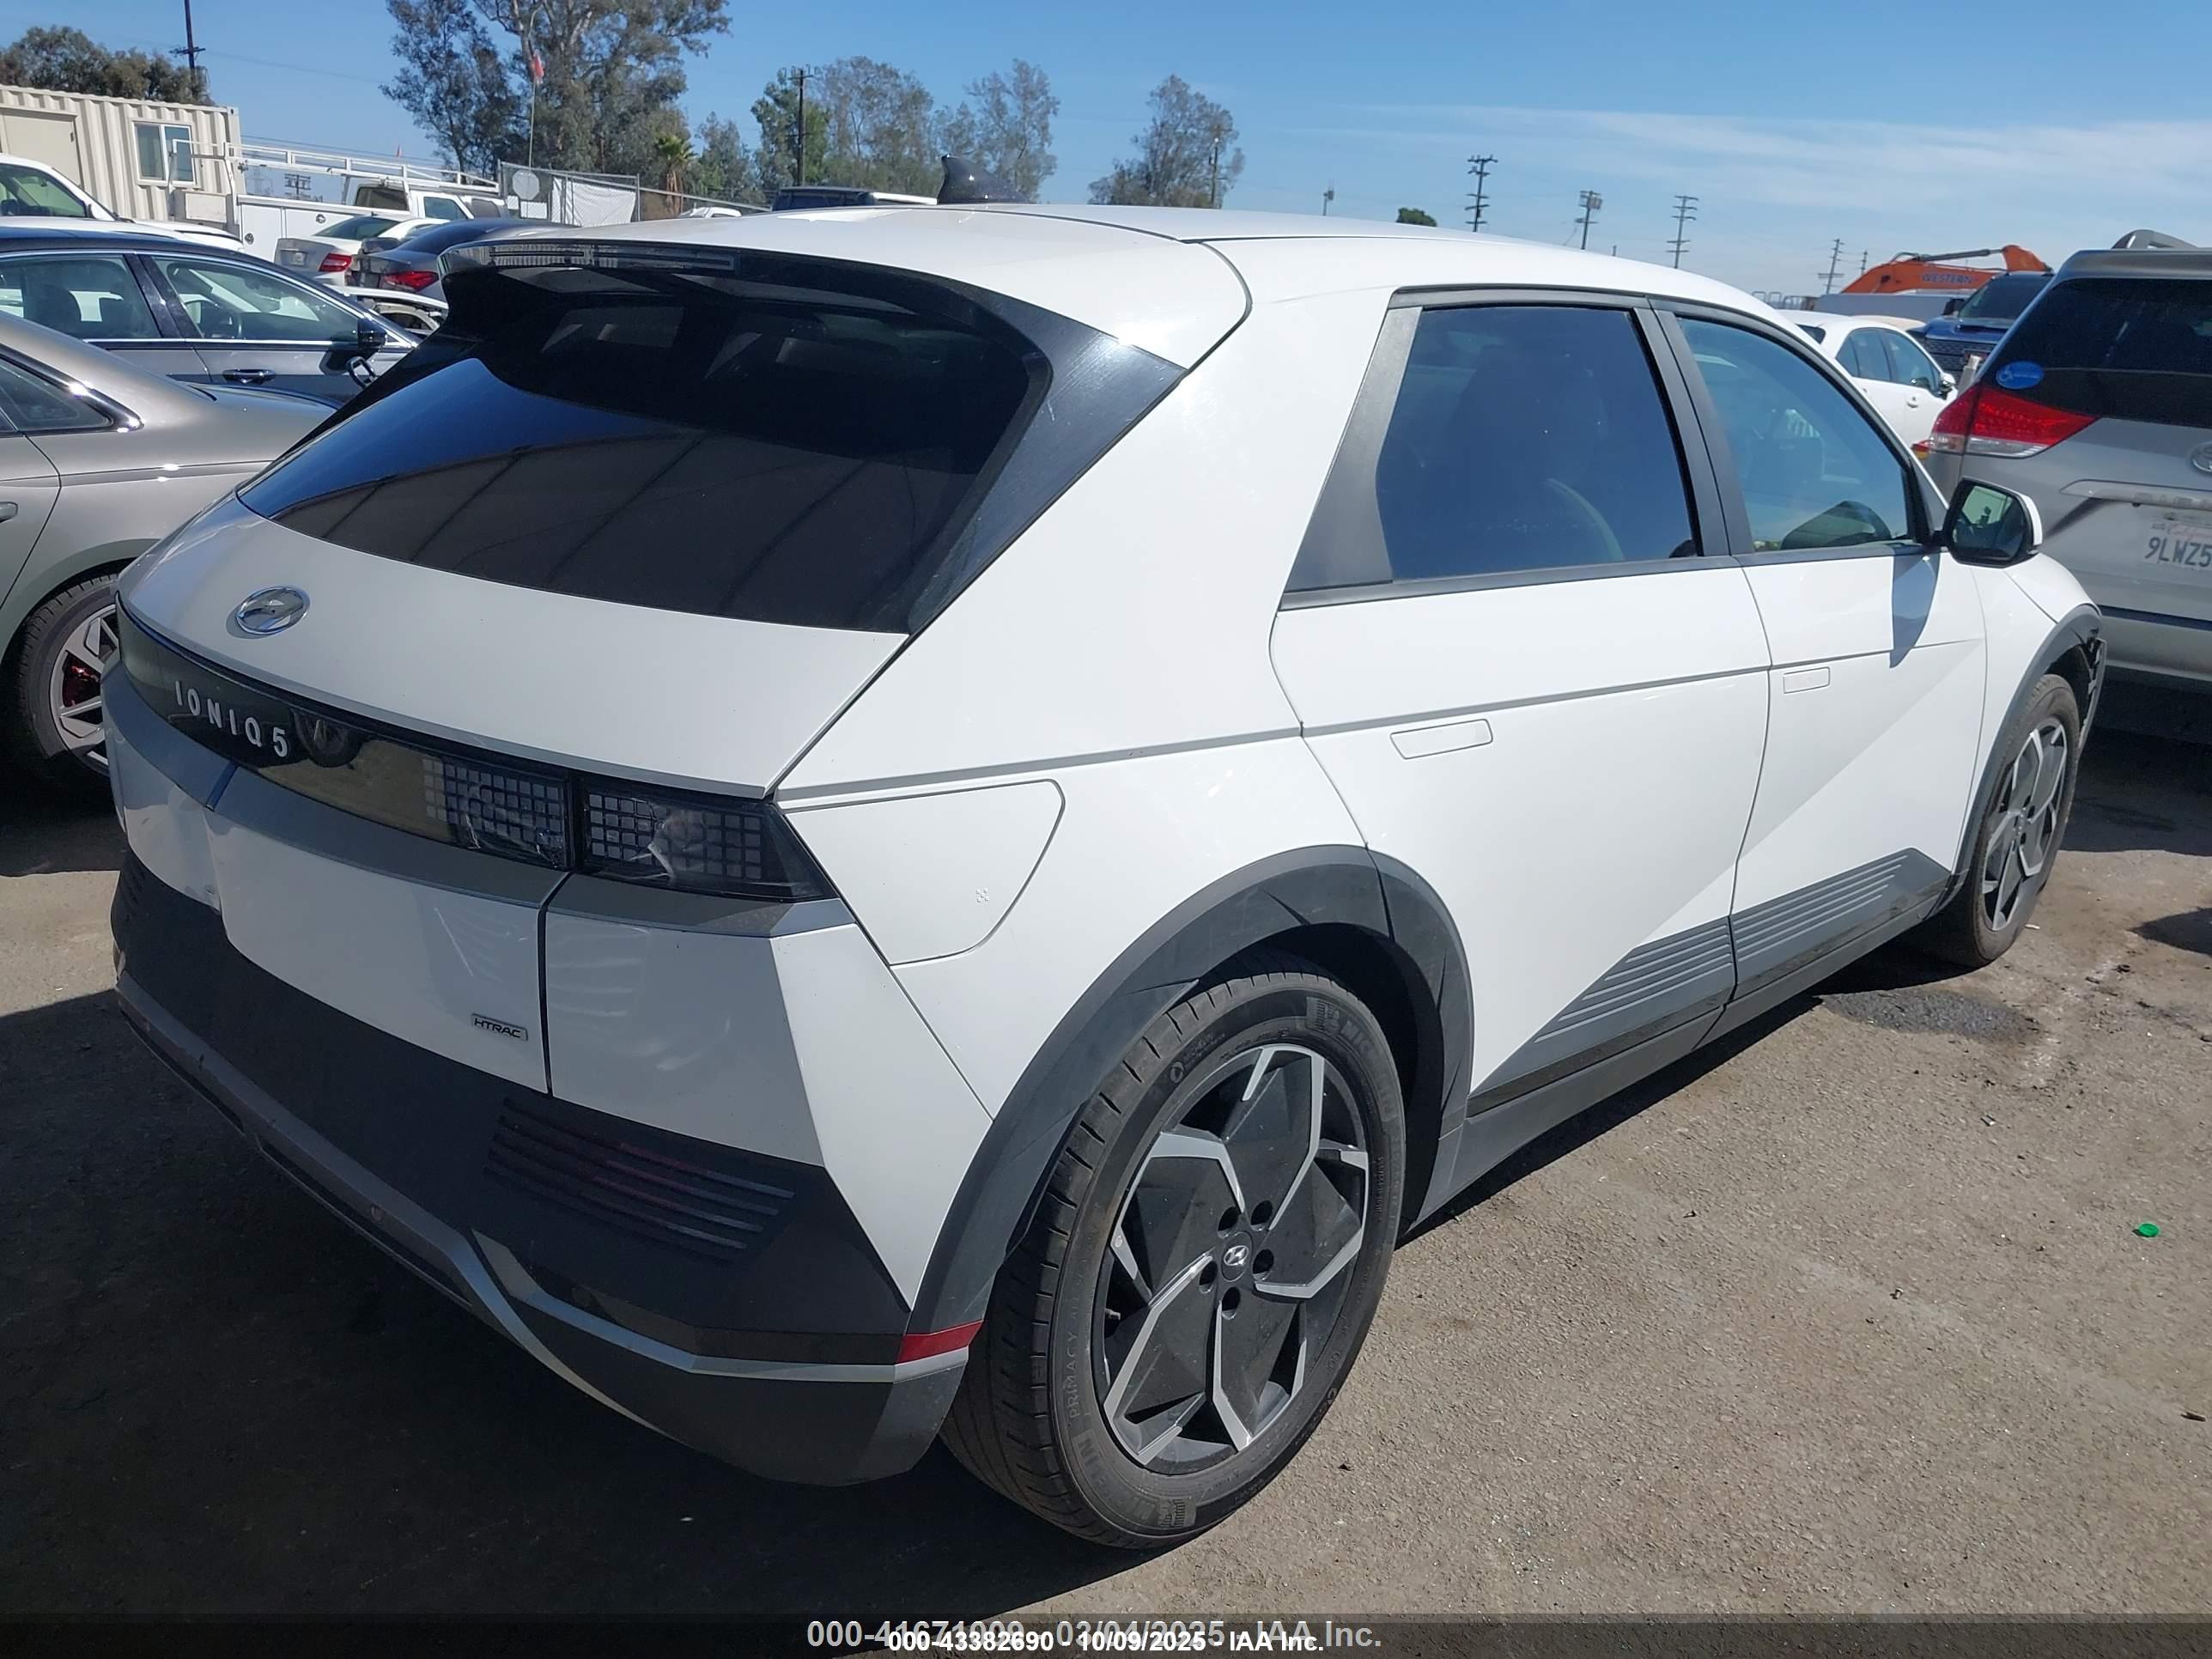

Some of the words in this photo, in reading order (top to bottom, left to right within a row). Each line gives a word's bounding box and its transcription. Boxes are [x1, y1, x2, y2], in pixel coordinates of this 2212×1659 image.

[1921, 273, 1972, 284] WESTERN
[175, 680, 263, 747] IONIQ
[272, 726, 289, 757] 5
[474, 1017, 521, 1038] HTRAC
[1066, 1332, 1080, 1419] PRIMACY
